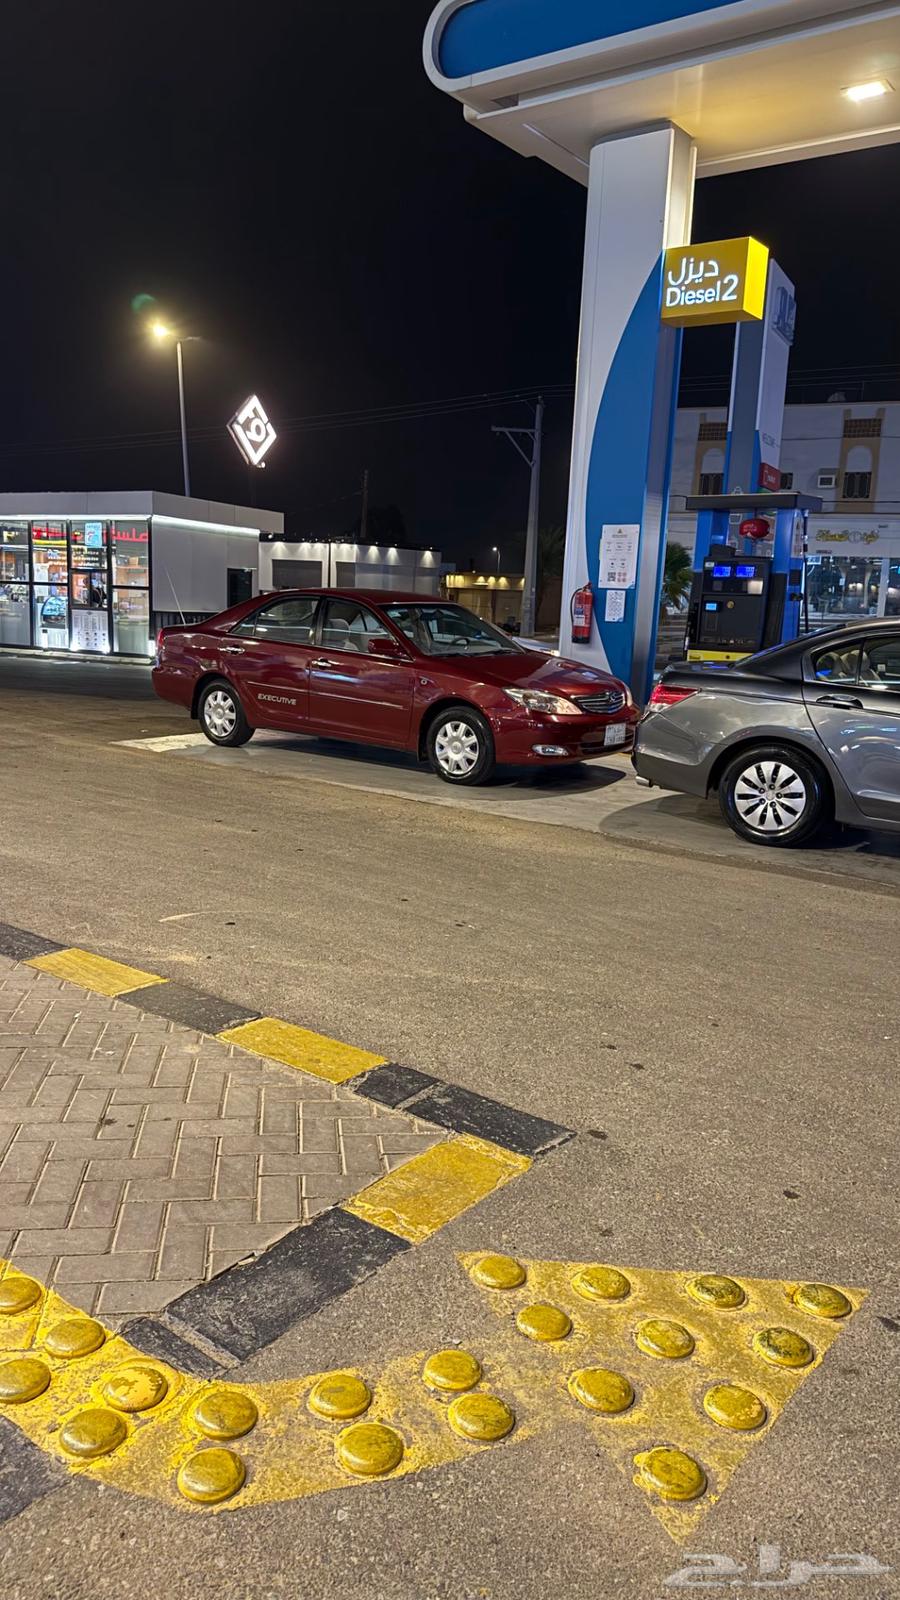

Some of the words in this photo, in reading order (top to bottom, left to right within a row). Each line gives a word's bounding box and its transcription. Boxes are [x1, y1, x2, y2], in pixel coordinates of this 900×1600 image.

[667, 256, 719, 287] ديزل
[666, 280, 720, 307] Diesel
[257, 693, 297, 706] EXECUTIVE
